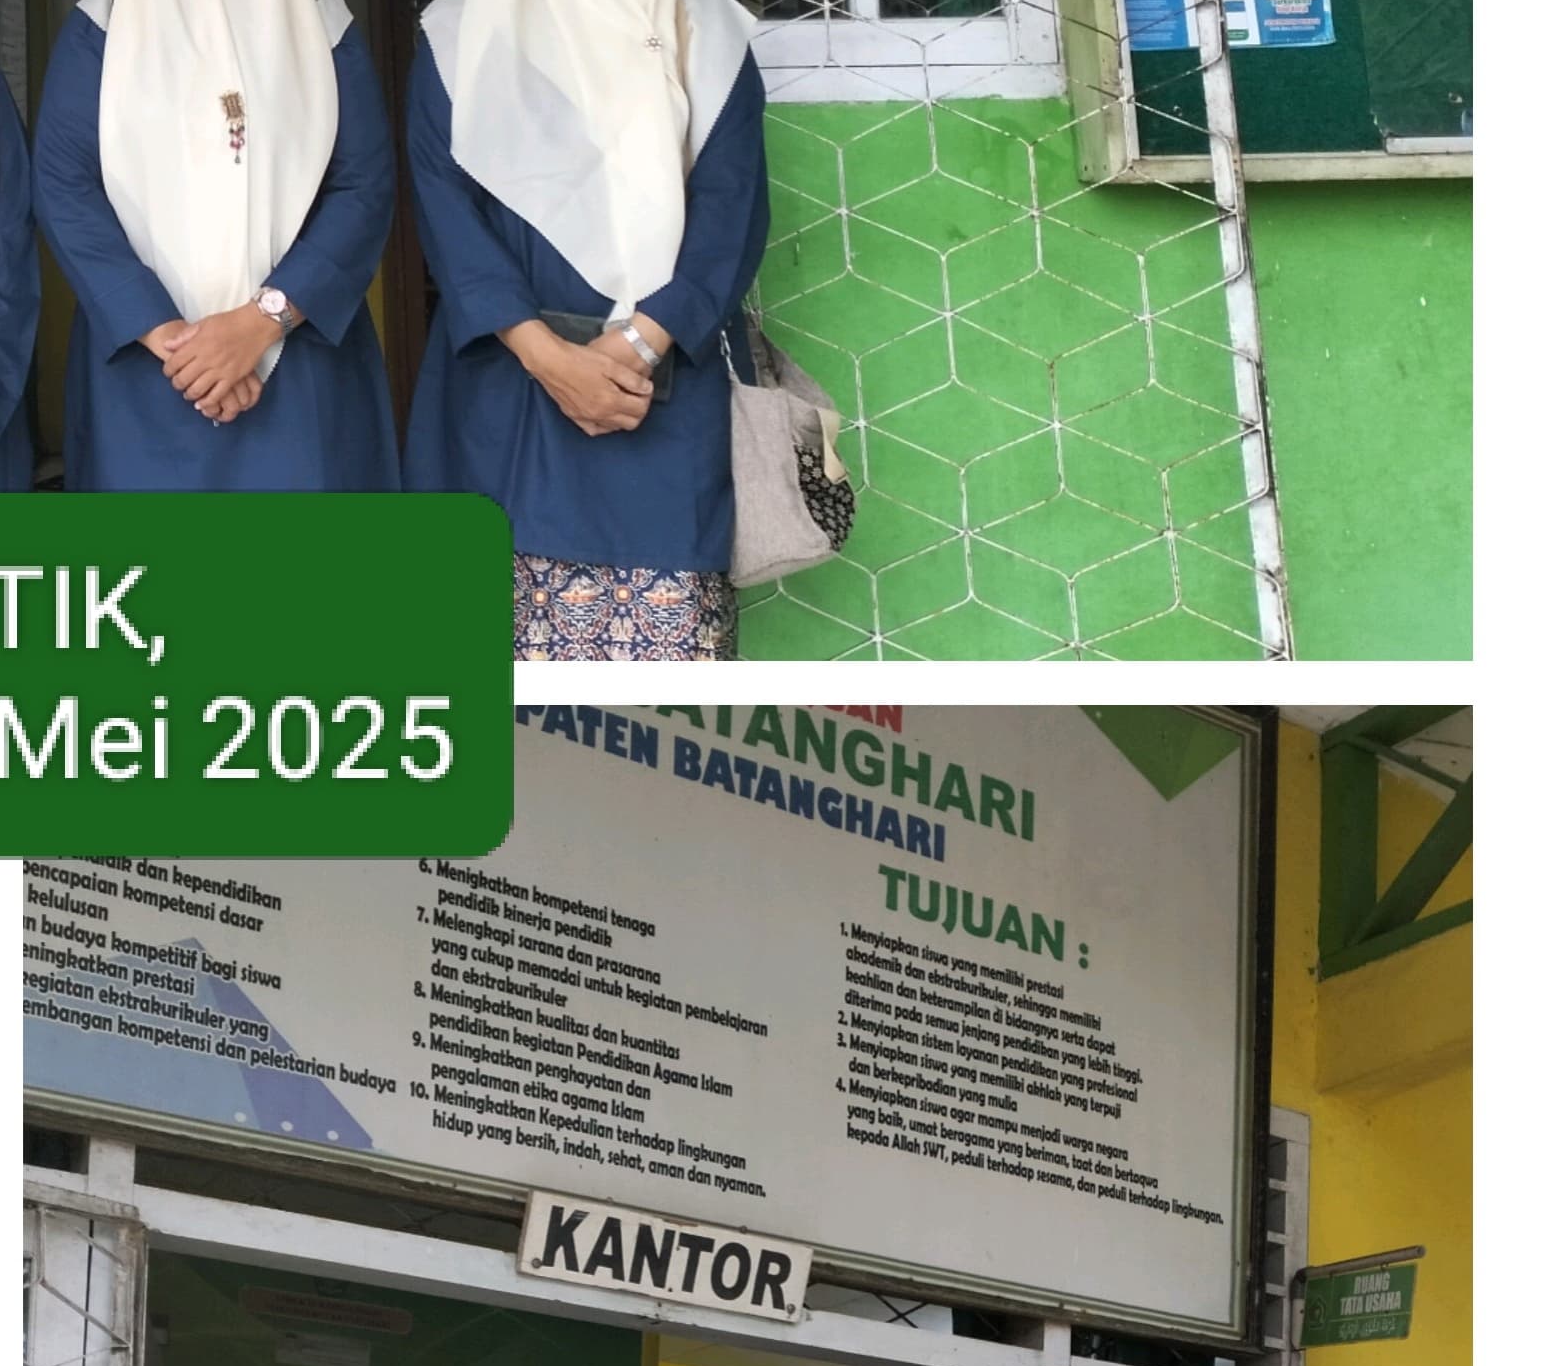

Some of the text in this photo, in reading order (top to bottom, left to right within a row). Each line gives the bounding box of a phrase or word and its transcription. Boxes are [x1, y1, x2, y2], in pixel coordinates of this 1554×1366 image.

[673, 735, 946, 863] BATANGHARI
[437, 888, 613, 948] pendidik kinerja pendidik
[878, 864, 1066, 962] TUJUAN
[411, 1030, 651, 1101] 9. Meningkatkan penghayatan dan
[872, 1061, 957, 1098] berkepribadian
[958, 1087, 986, 1107] yang
[987, 1093, 1018, 1113] mulia
[541, 1205, 792, 1311] KANTOR
[1354, 1271, 1391, 1295] RUANG
[1340, 1291, 1402, 1316] TATA USAHA
